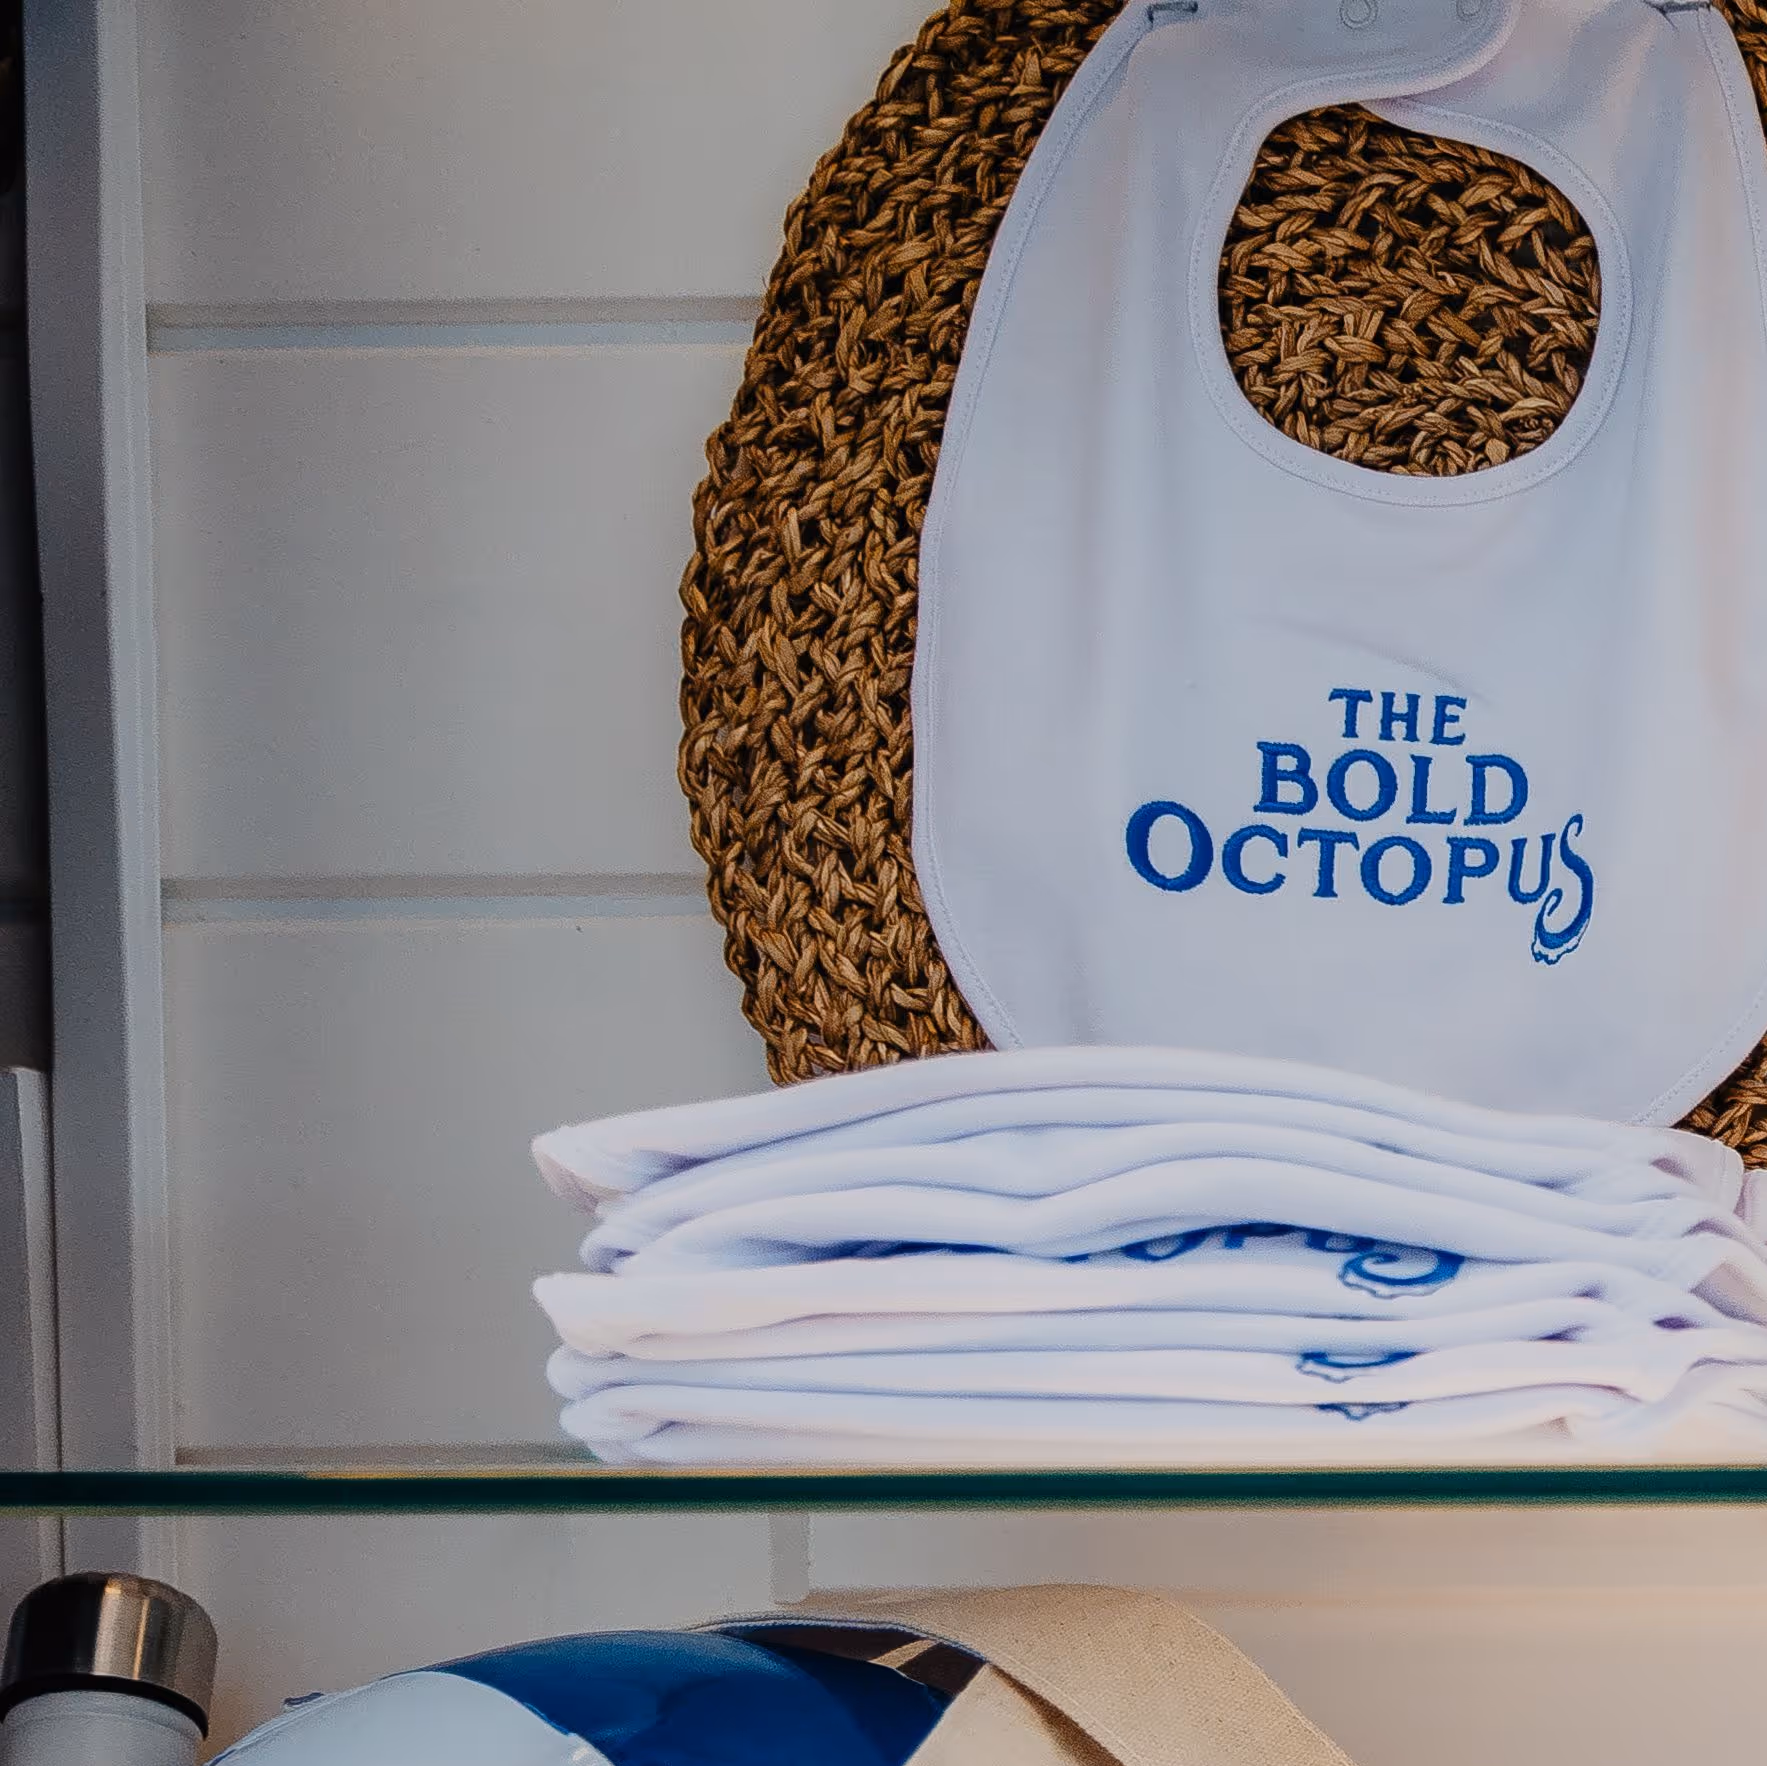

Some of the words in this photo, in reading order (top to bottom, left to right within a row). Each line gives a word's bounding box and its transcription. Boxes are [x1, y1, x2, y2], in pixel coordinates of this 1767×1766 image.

[1328, 688, 1467, 746] THE
[1253, 741, 1529, 826] BOLD
[1126, 800, 1594, 965] OCTOPUS
